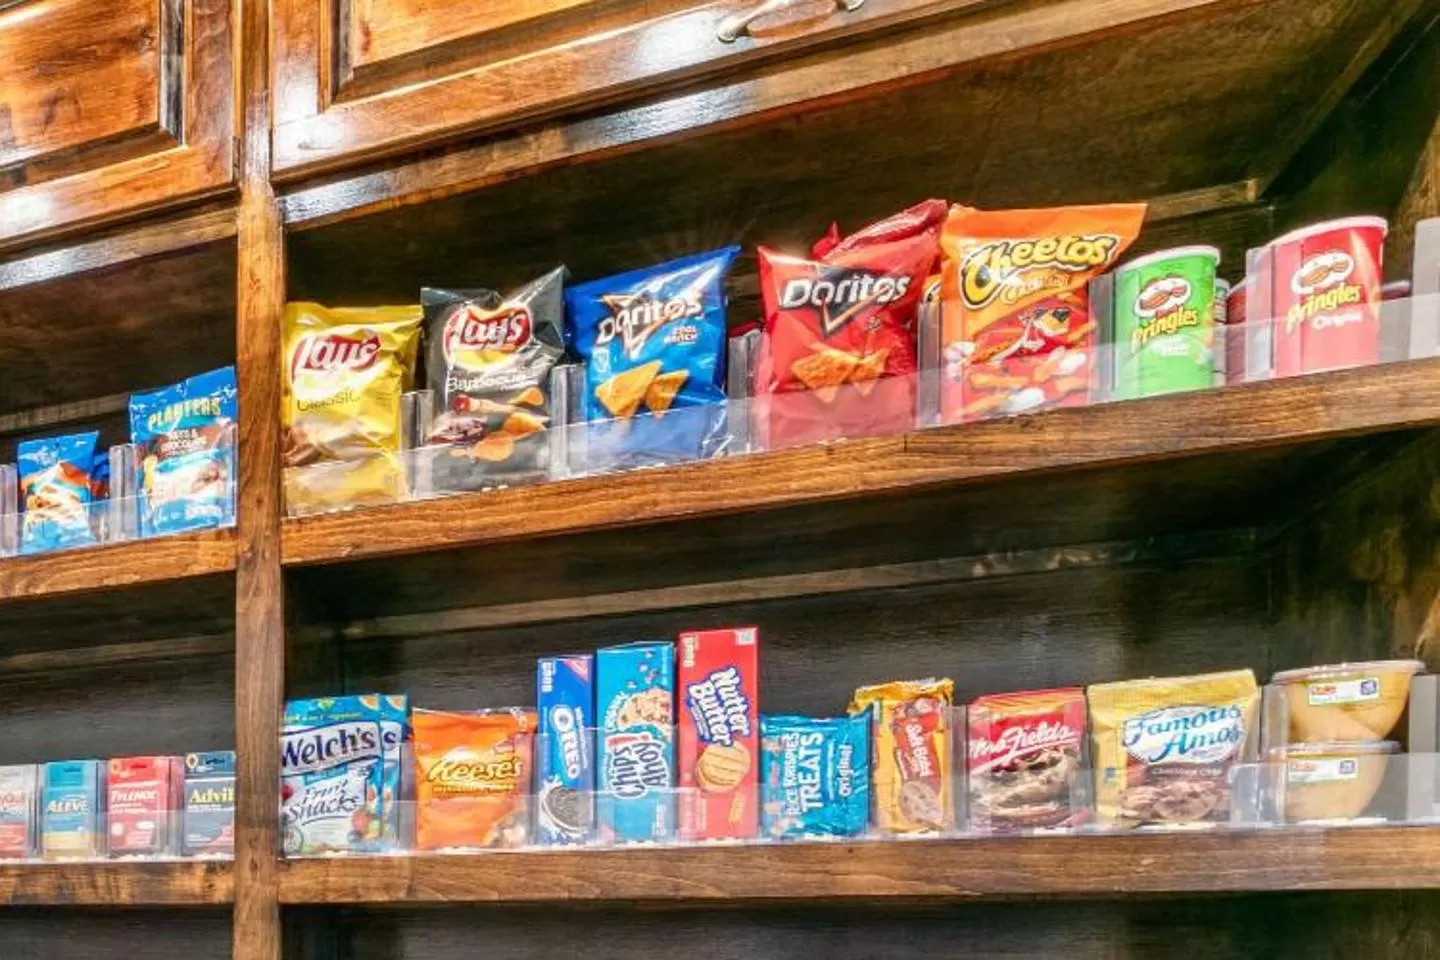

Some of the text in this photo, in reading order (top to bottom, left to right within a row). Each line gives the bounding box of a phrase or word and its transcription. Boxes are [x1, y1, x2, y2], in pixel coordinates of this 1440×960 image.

[783, 274, 911, 309] Doritos
[962, 233, 1118, 308] Cheetos
[596, 290, 703, 346] Doritos
[1131, 306, 1198, 355] Pringles
[1287, 281, 1362, 334] Pringles
[689, 683, 734, 747] Butter
[709, 667, 750, 737] Nutter
[1124, 704, 1242, 746] Famous
[282, 727, 377, 767] Welch's
[551, 704, 581, 779] OREO
[1148, 724, 1241, 763] Amos
[189, 786, 235, 804] Advil
[428, 756, 523, 783] Reese's
[611, 745, 646, 799] Chips
[799, 731, 824, 813] TREATS
[837, 744, 854, 797] original
